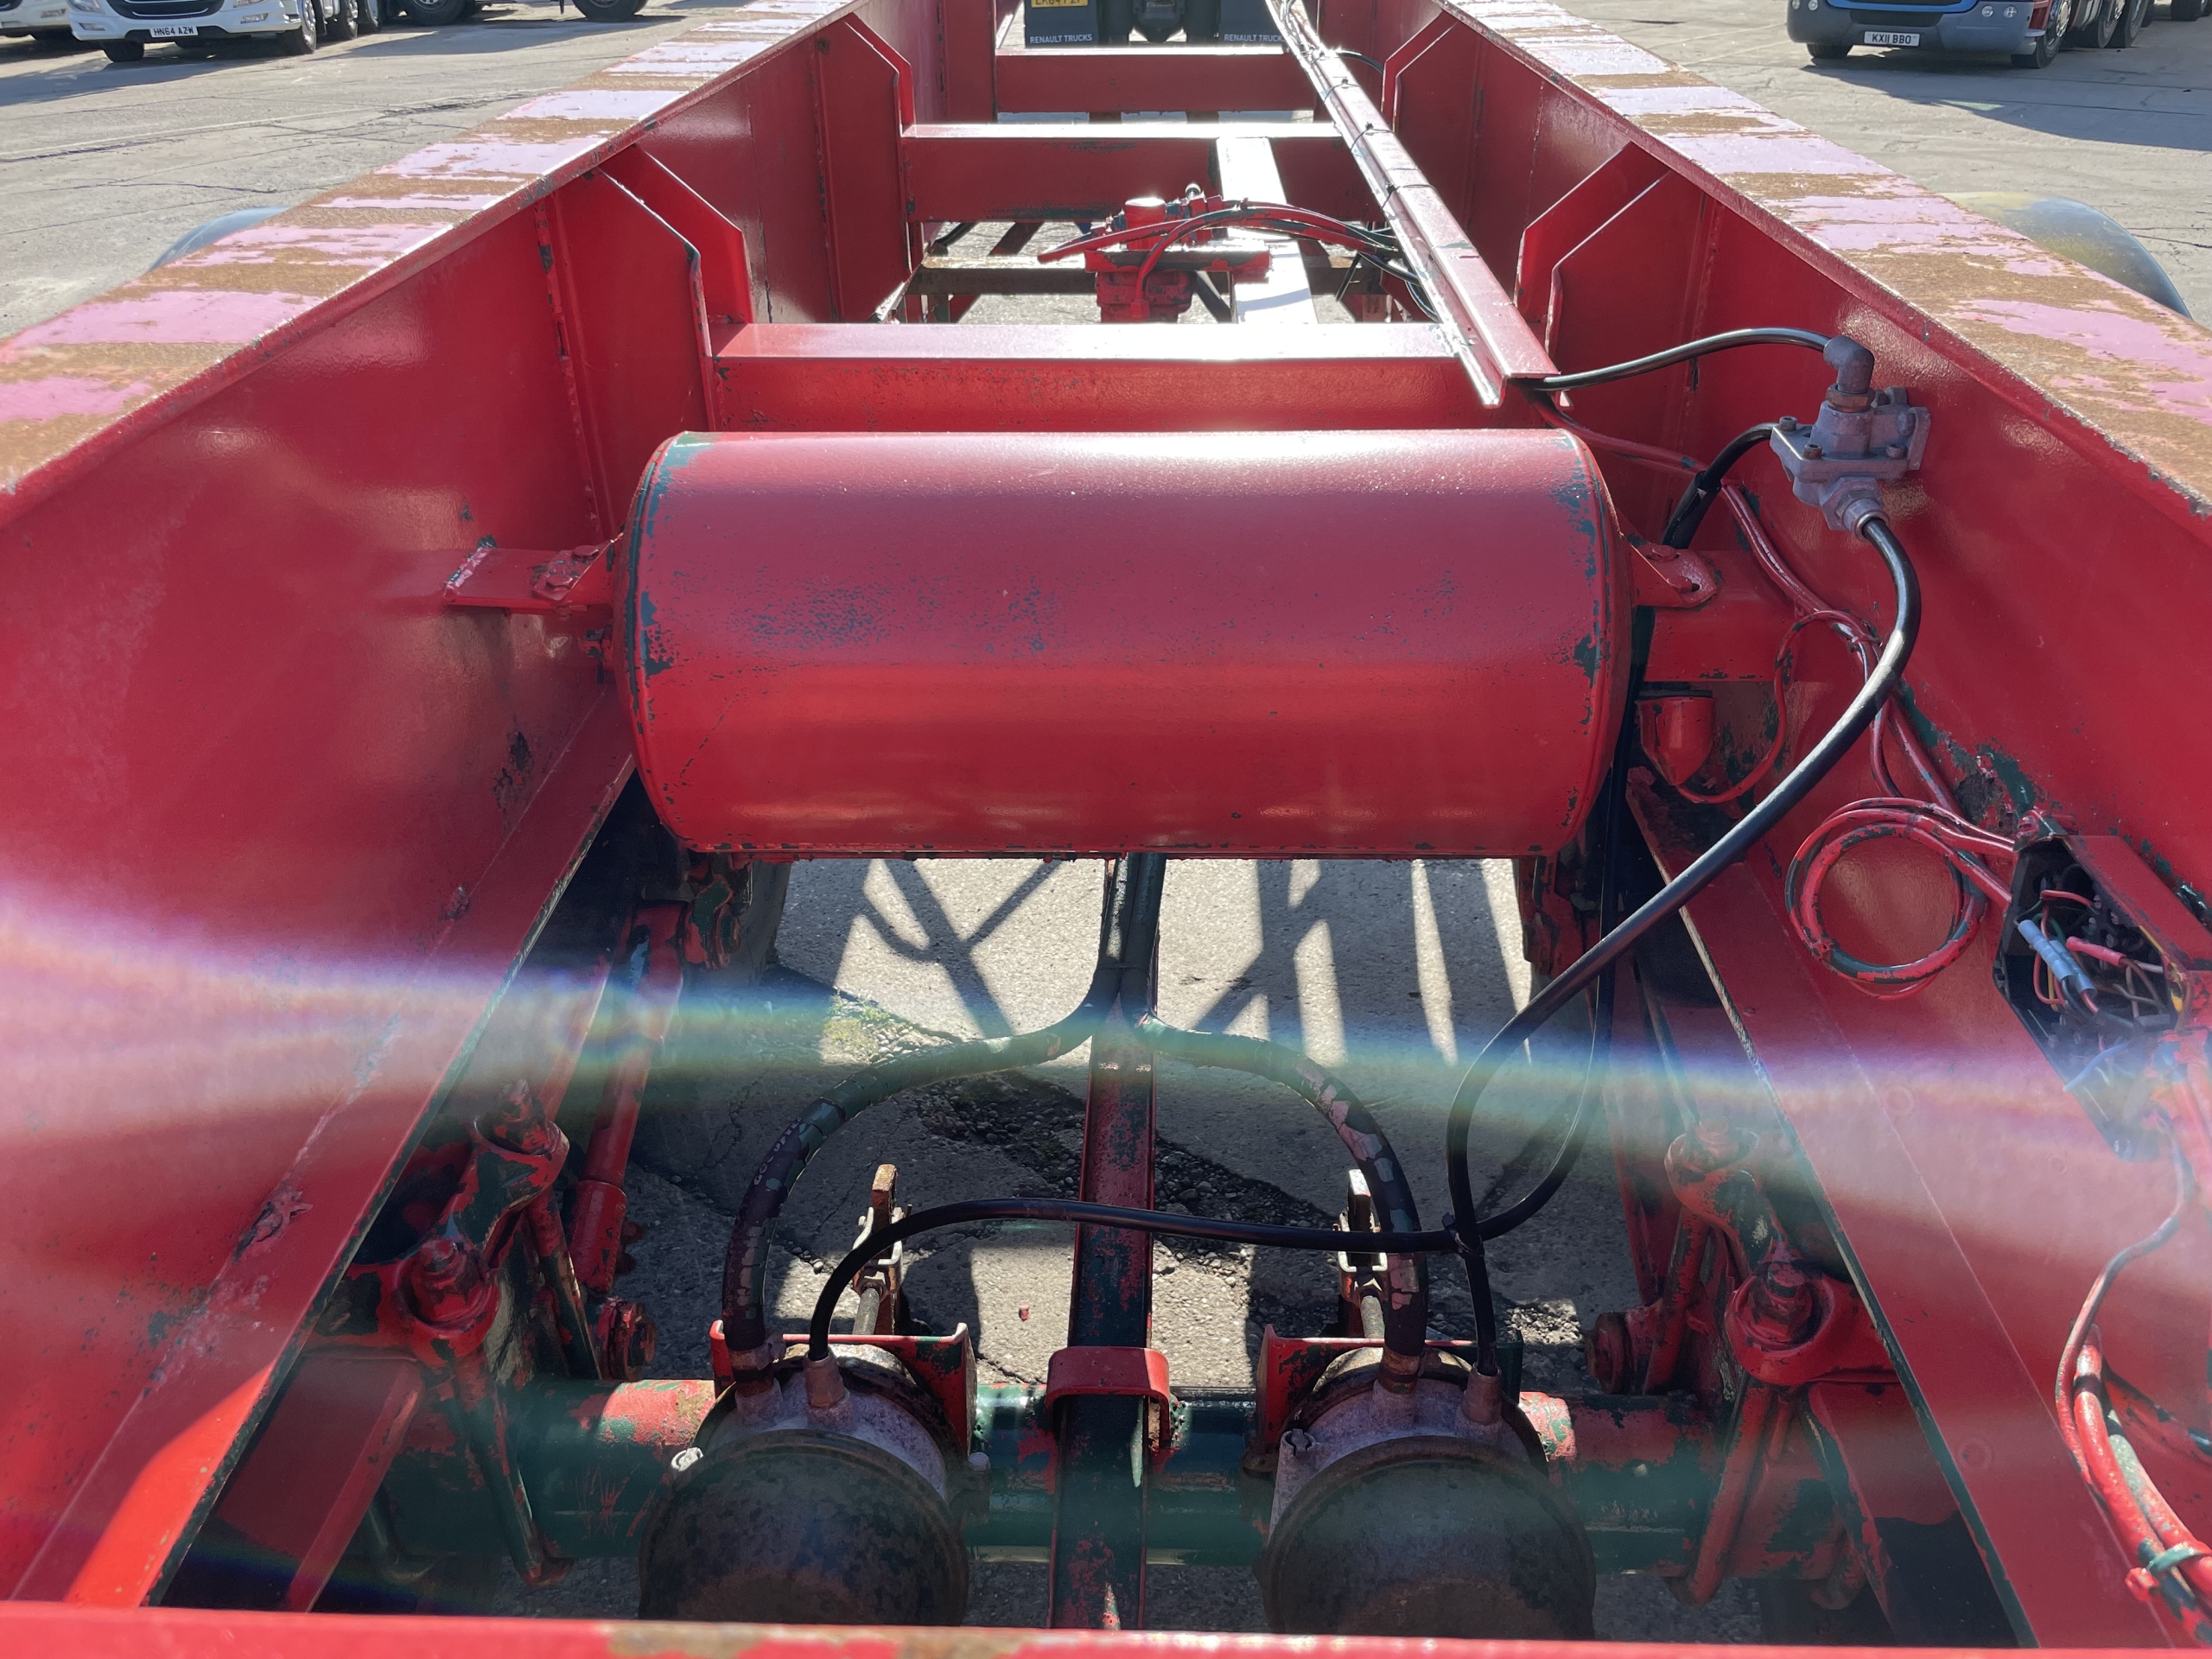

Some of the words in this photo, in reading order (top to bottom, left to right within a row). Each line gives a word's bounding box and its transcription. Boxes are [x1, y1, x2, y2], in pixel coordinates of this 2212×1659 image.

[153, 27, 175, 35] HN64
[178, 26, 194, 35] AZW
[1029, 35, 1062, 44] RENAULT
[1064, 34, 1093, 42] TRUCKS
[1224, 34, 1257, 42] RENAULT
[1872, 33, 1891, 43] KX11
